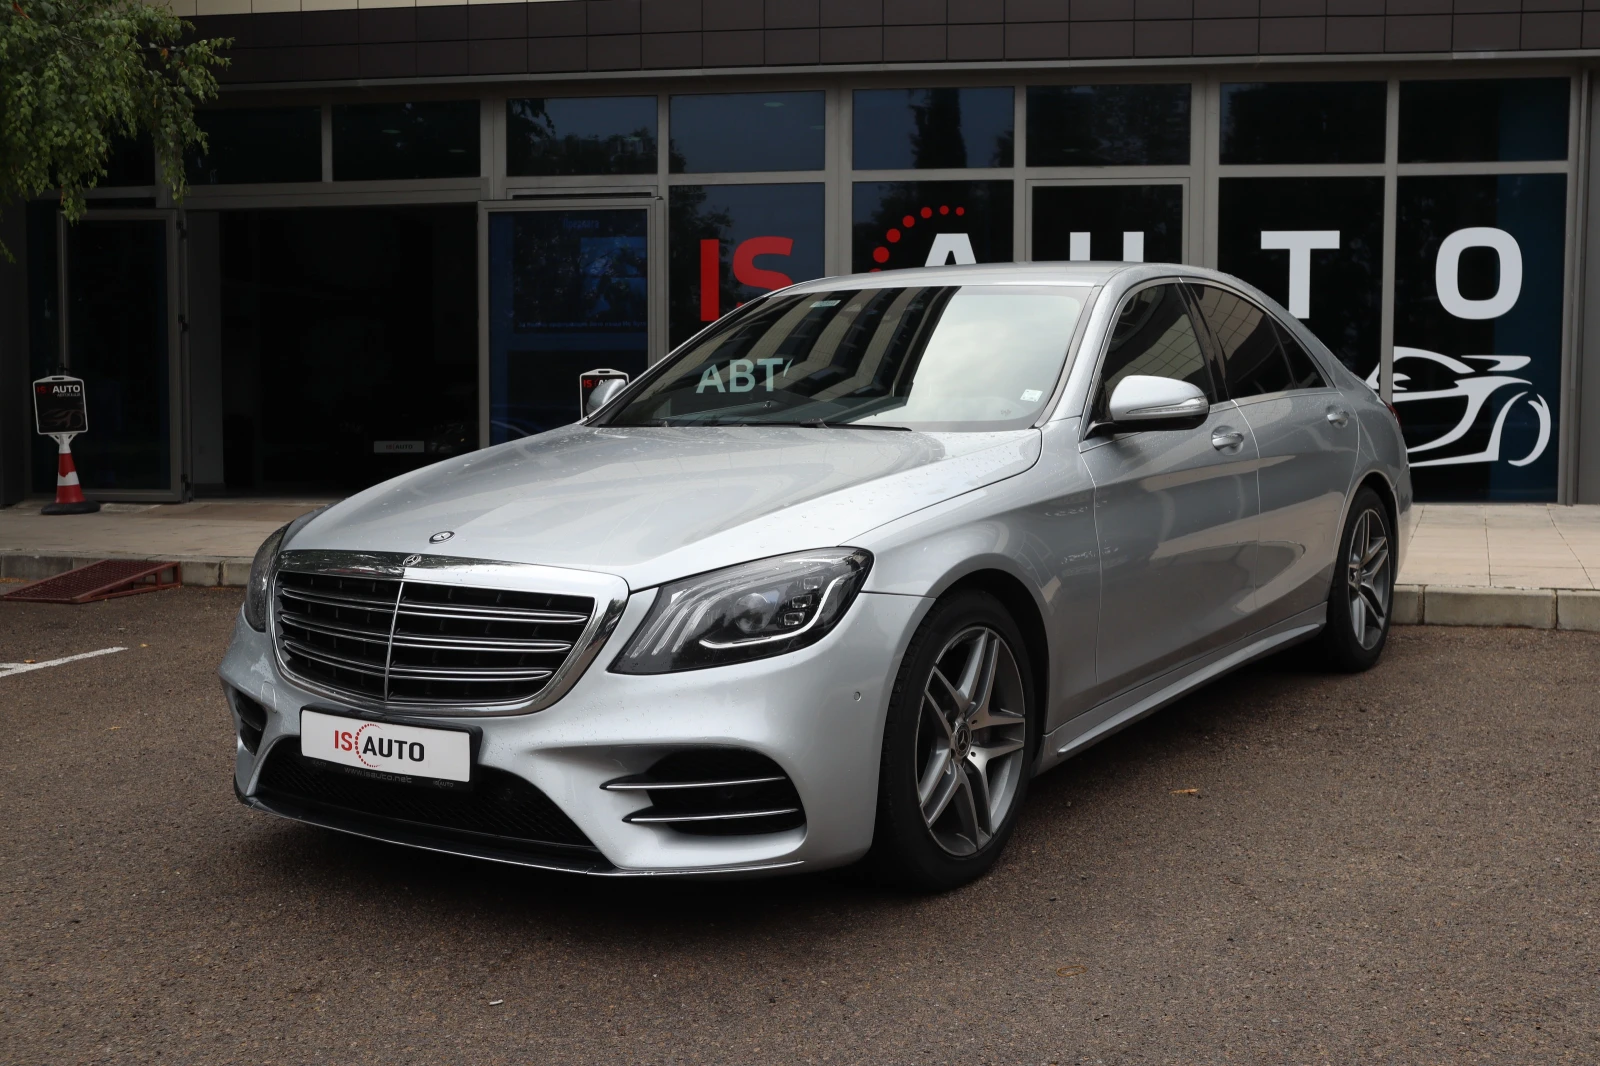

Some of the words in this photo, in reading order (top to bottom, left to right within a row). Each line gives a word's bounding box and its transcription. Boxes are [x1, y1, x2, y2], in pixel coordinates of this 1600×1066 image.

[701, 236, 793, 322] IS
[52, 385, 80, 394] AUTO
[583, 380, 592, 388] IS
[335, 730, 353, 752] IS
[363, 736, 425, 763] AUTO
[344, 766, 413, 784] www.isauto.net
